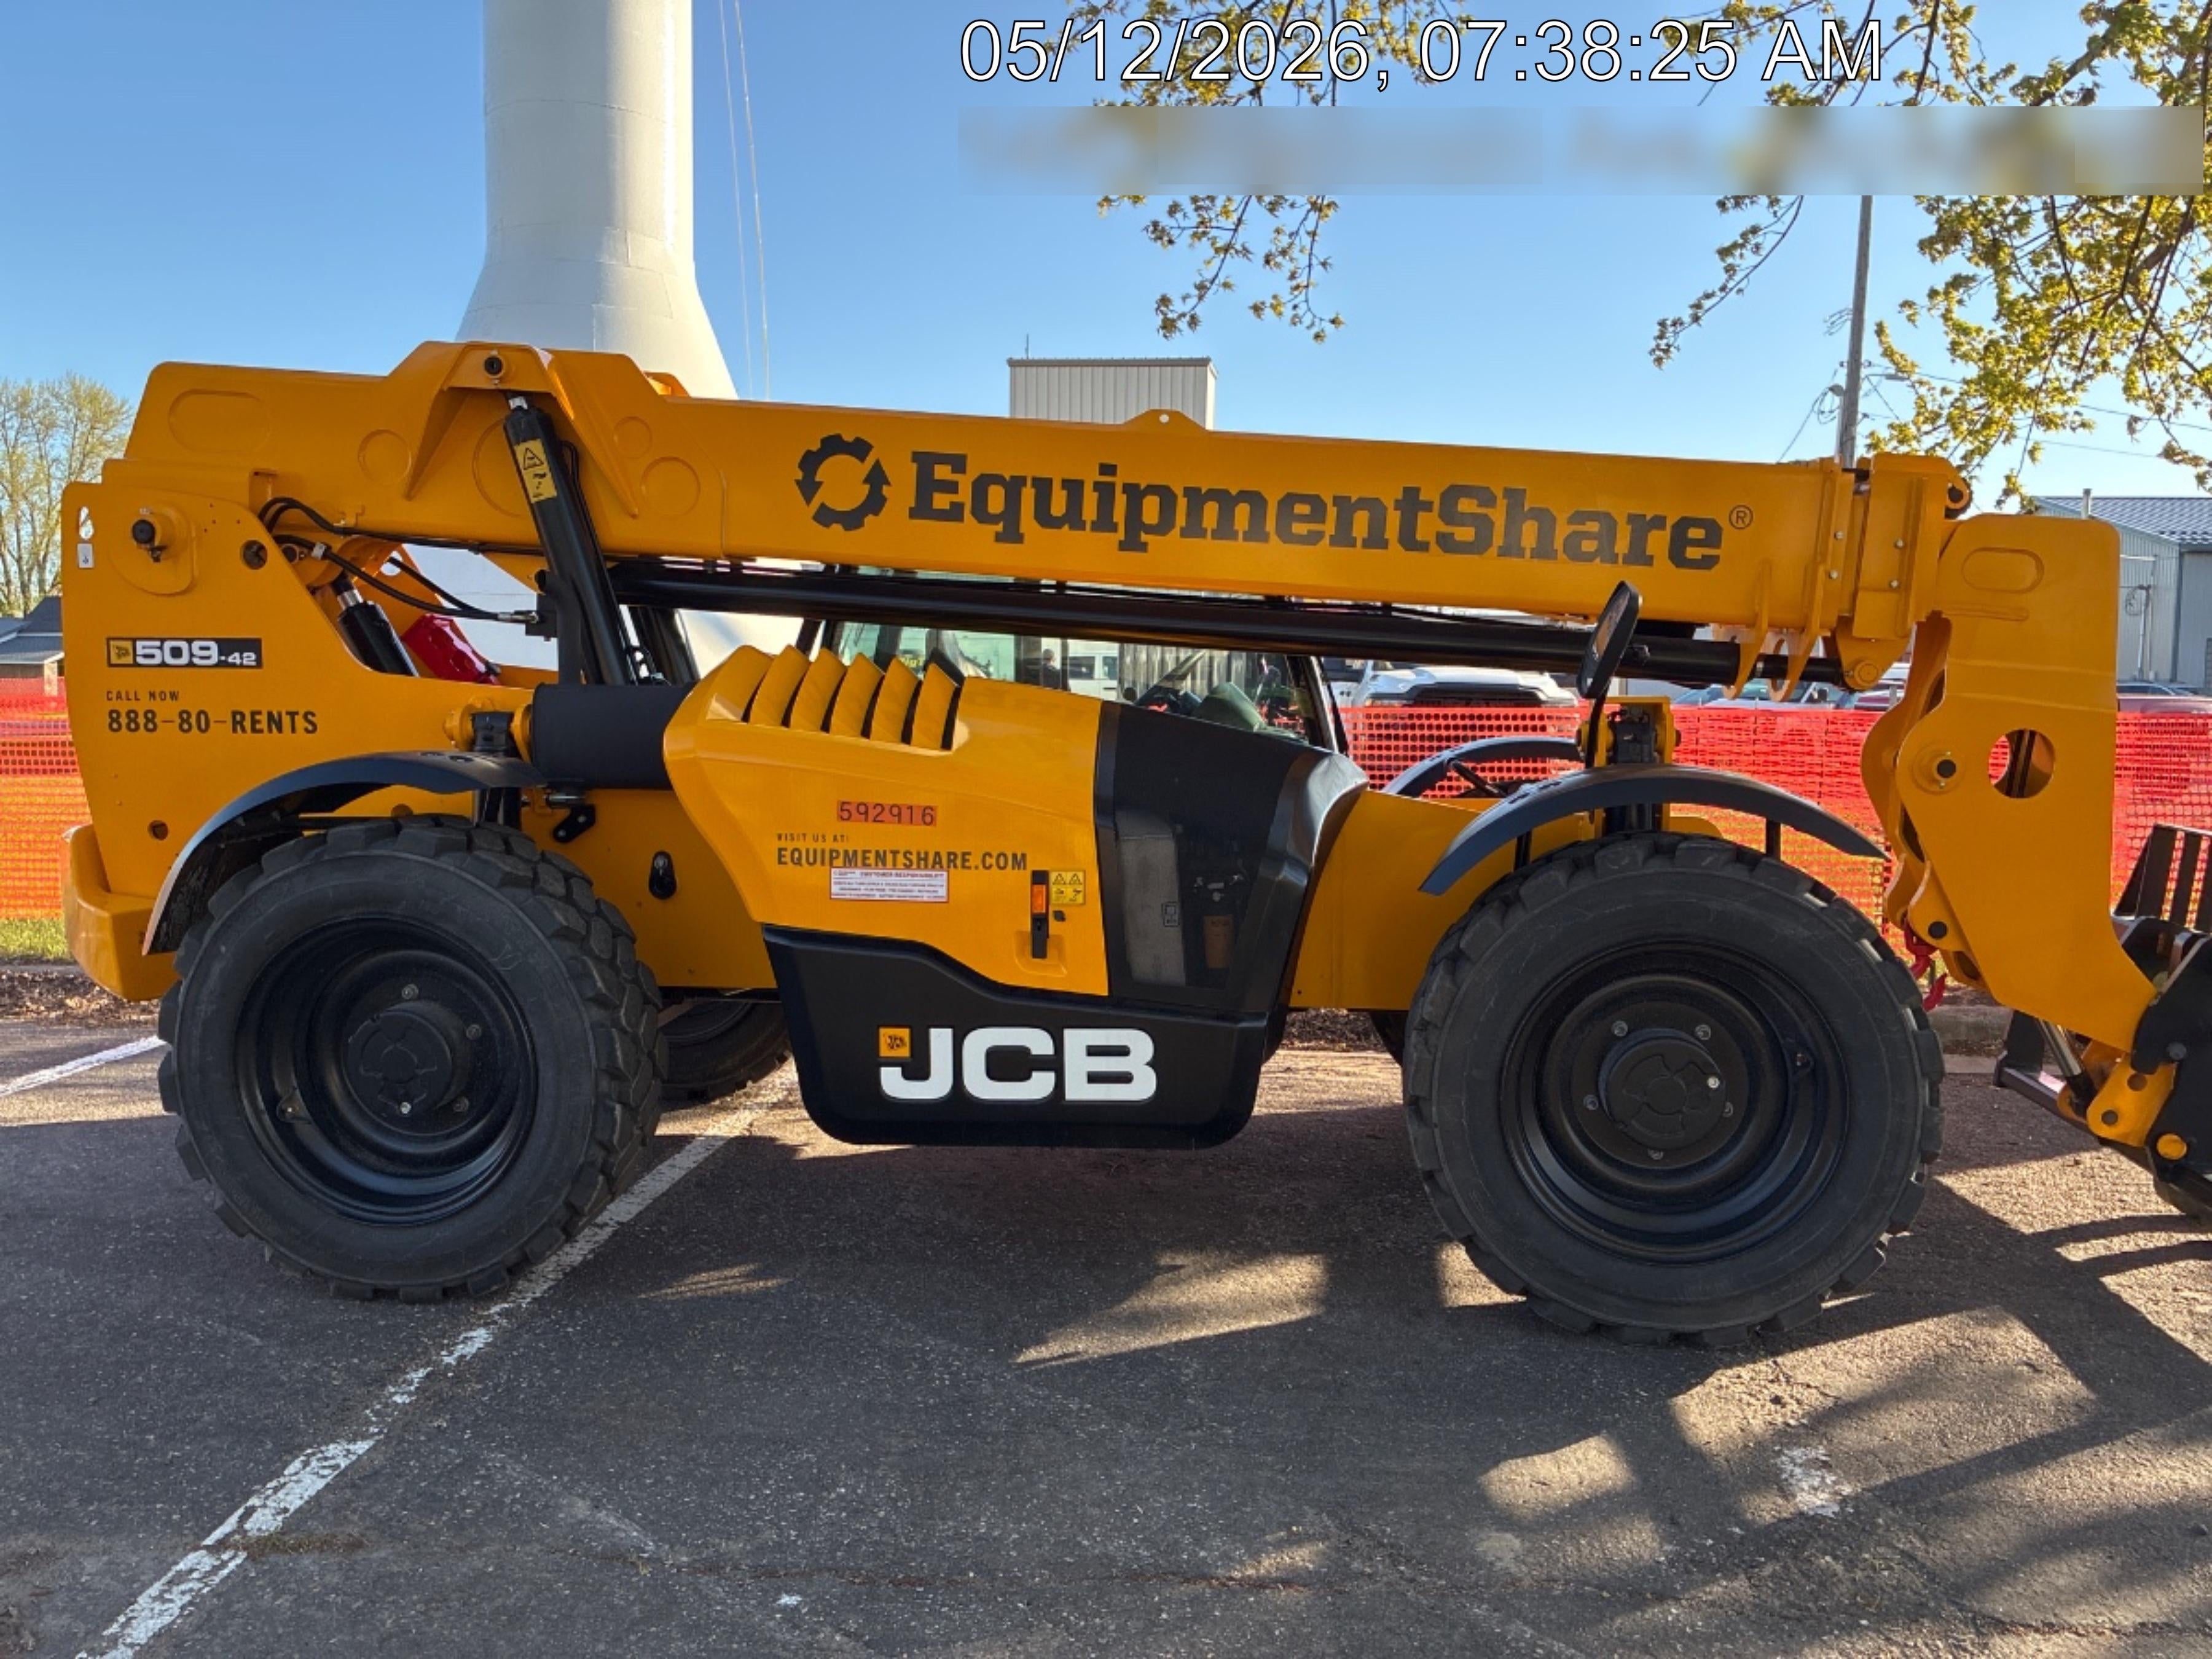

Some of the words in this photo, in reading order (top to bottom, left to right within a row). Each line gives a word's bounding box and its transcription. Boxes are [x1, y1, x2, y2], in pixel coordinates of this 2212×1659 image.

[136, 640, 257, 665] 509-42
[106, 691, 141, 701] CALL
[149, 691, 179, 701] NOW
[108, 709, 318, 734] 888-80-RENTS
[840, 801, 935, 826] 592916
[813, 834, 826, 842] US
[777, 847, 1027, 869] EQUIPMENTSHARE.COM
[880, 1027, 1157, 1100] JCB
